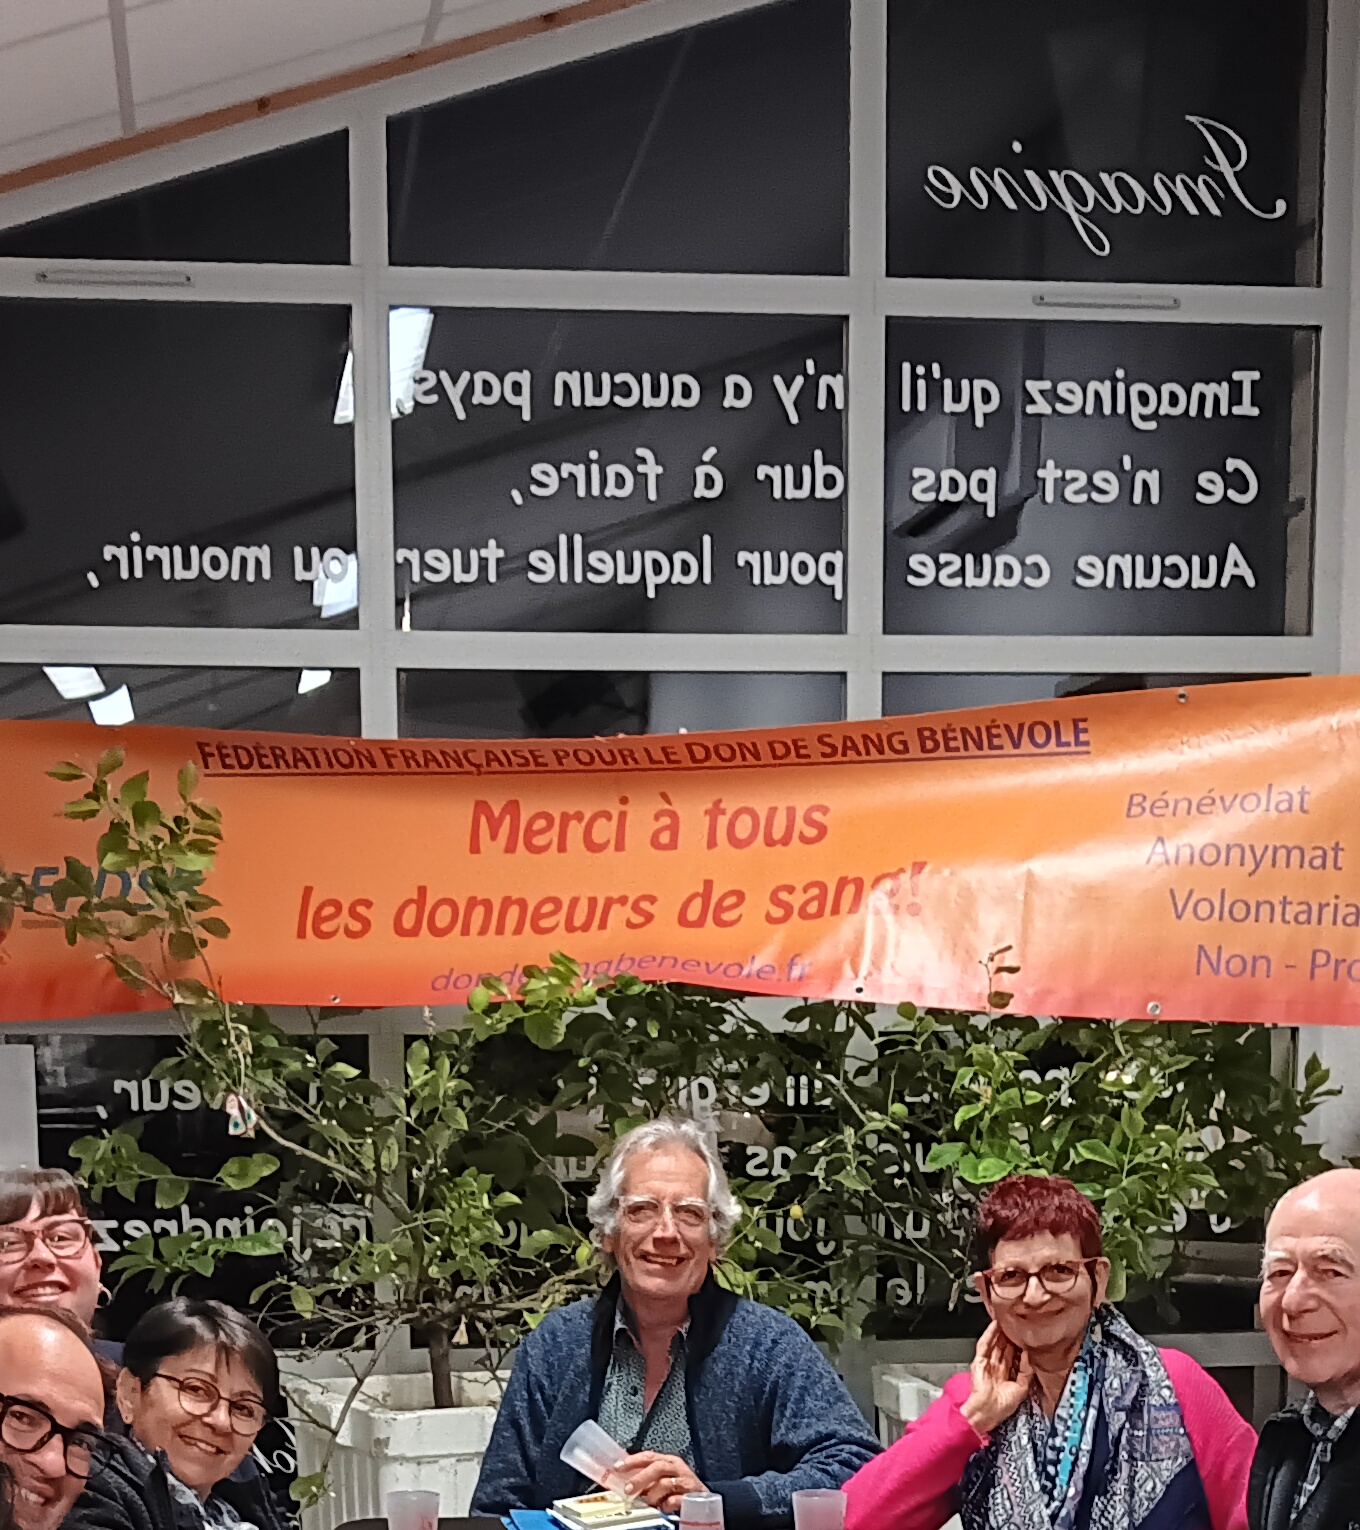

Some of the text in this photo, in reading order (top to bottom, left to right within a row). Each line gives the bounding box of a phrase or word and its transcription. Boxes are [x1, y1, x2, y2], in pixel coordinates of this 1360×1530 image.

[197, 717, 1090, 775] FÉDÉRATION FRANÇAISE POUR LE DON DE SANG BÉNÉVOLE
[469, 791, 831, 855] Merci à tous
[1125, 783, 1311, 819] Bénévolat
[1145, 836, 1344, 877] Anonymat
[296, 886, 374, 940] les
[393, 885, 656, 939] donneurs
[677, 878, 747, 929] de
[1196, 944, 1272, 979] Non
